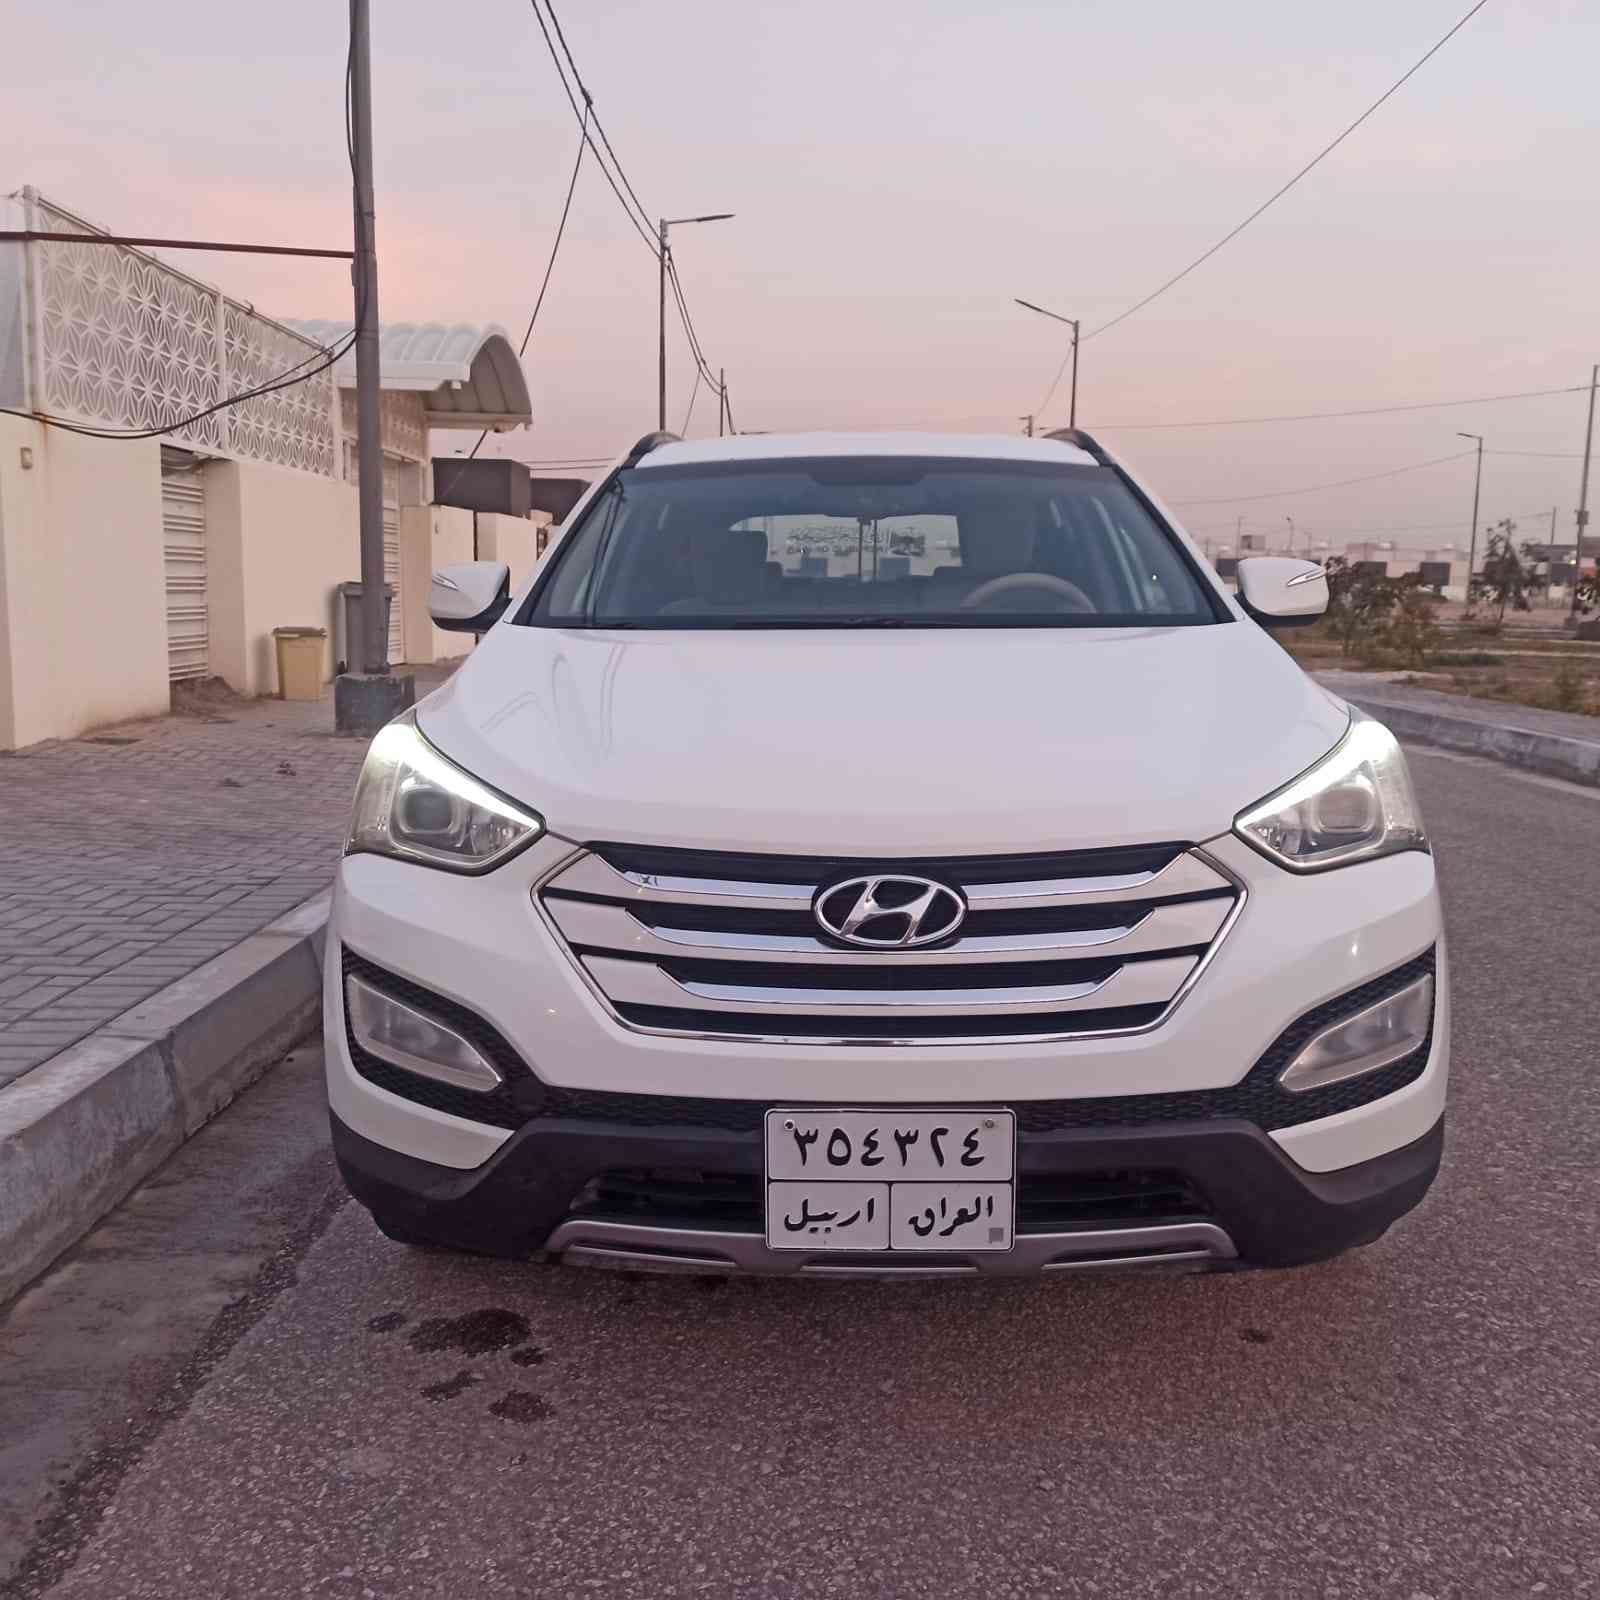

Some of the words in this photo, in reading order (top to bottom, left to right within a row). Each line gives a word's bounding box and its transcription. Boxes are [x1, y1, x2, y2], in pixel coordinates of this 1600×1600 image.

[793, 1127, 985, 1168] ٣٥٤٣٢٤
[783, 1197, 876, 1234] اربيل
[907, 1195, 994, 1237] العراق
